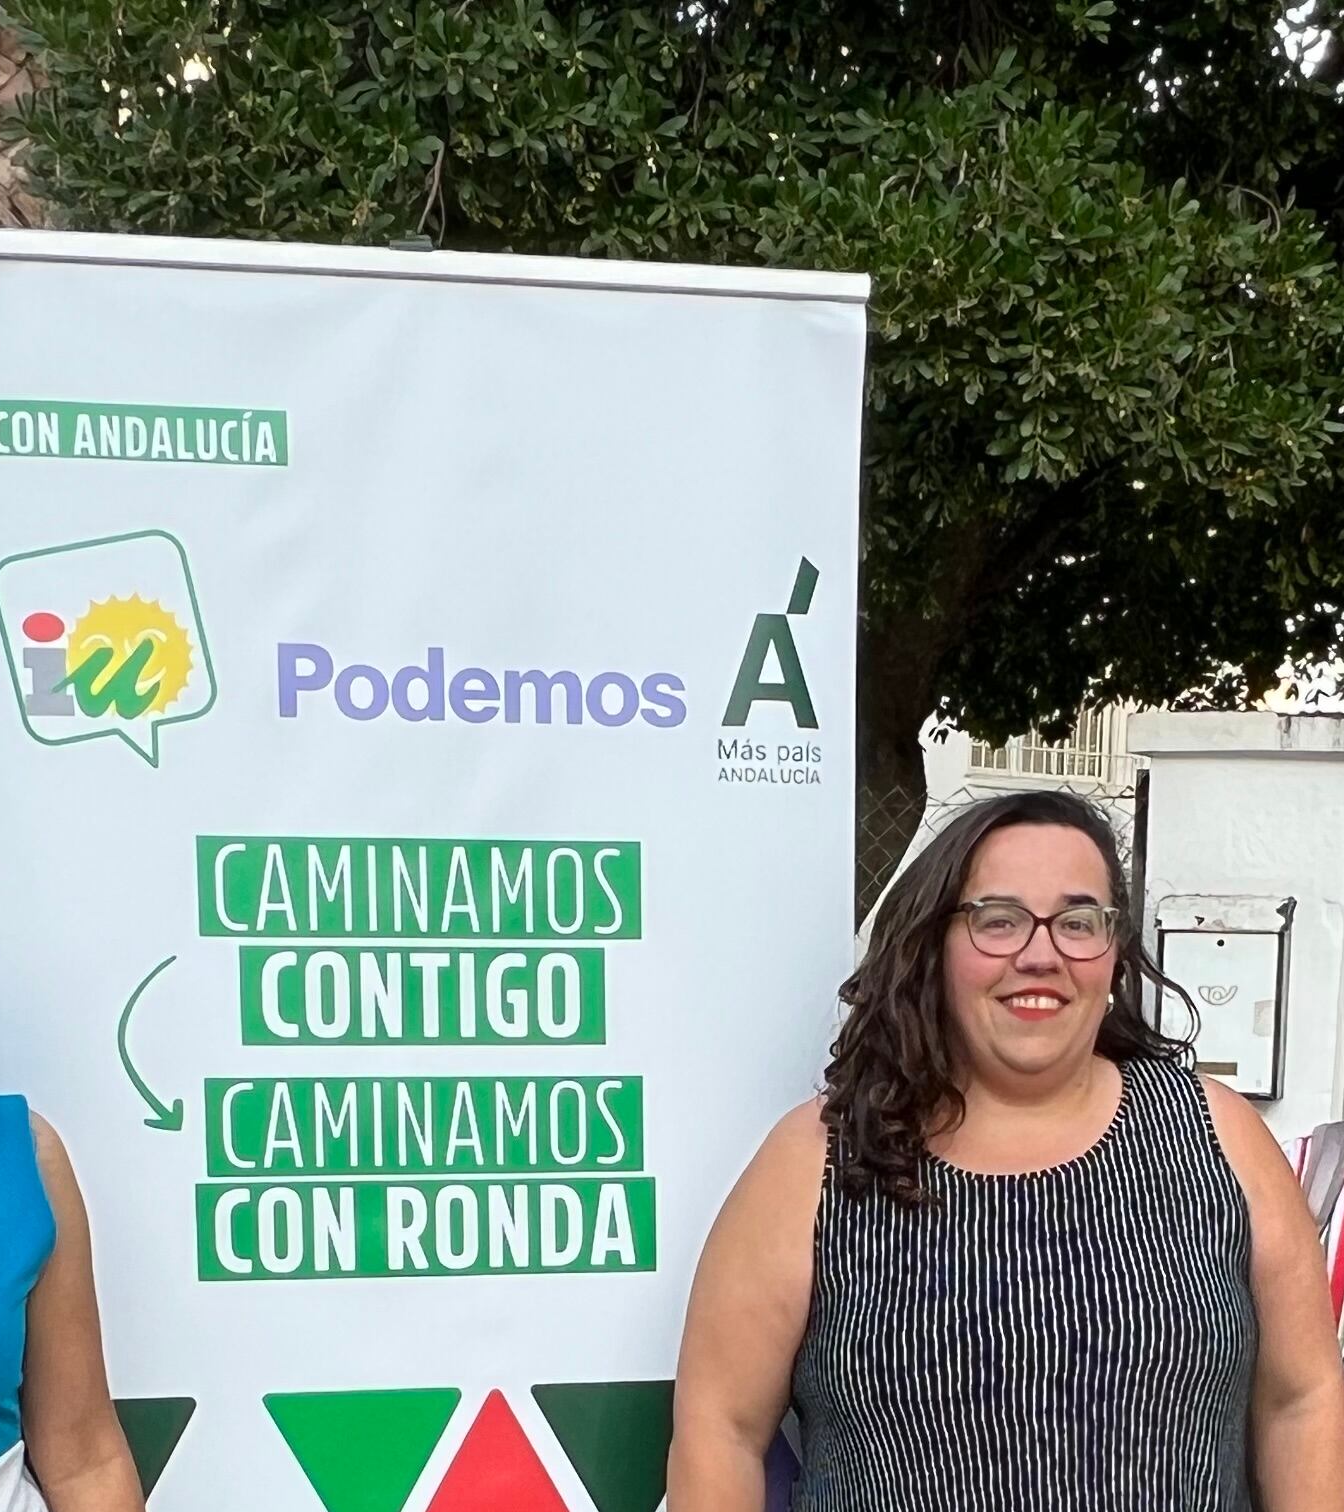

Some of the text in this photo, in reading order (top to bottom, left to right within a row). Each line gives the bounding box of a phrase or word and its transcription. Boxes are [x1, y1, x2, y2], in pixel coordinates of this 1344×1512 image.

[73, 410, 278, 463] ANDALUCÍA
[276, 642, 688, 728] Podemos
[717, 738, 822, 765] Más país
[718, 767, 821, 785] ANDALUCÍA
[214, 843, 623, 935] CAMINAMOS
[261, 950, 581, 1038] CONTIGO
[221, 1080, 625, 1169] CAMINAMOS
[214, 1183, 637, 1274] CON RONDA
